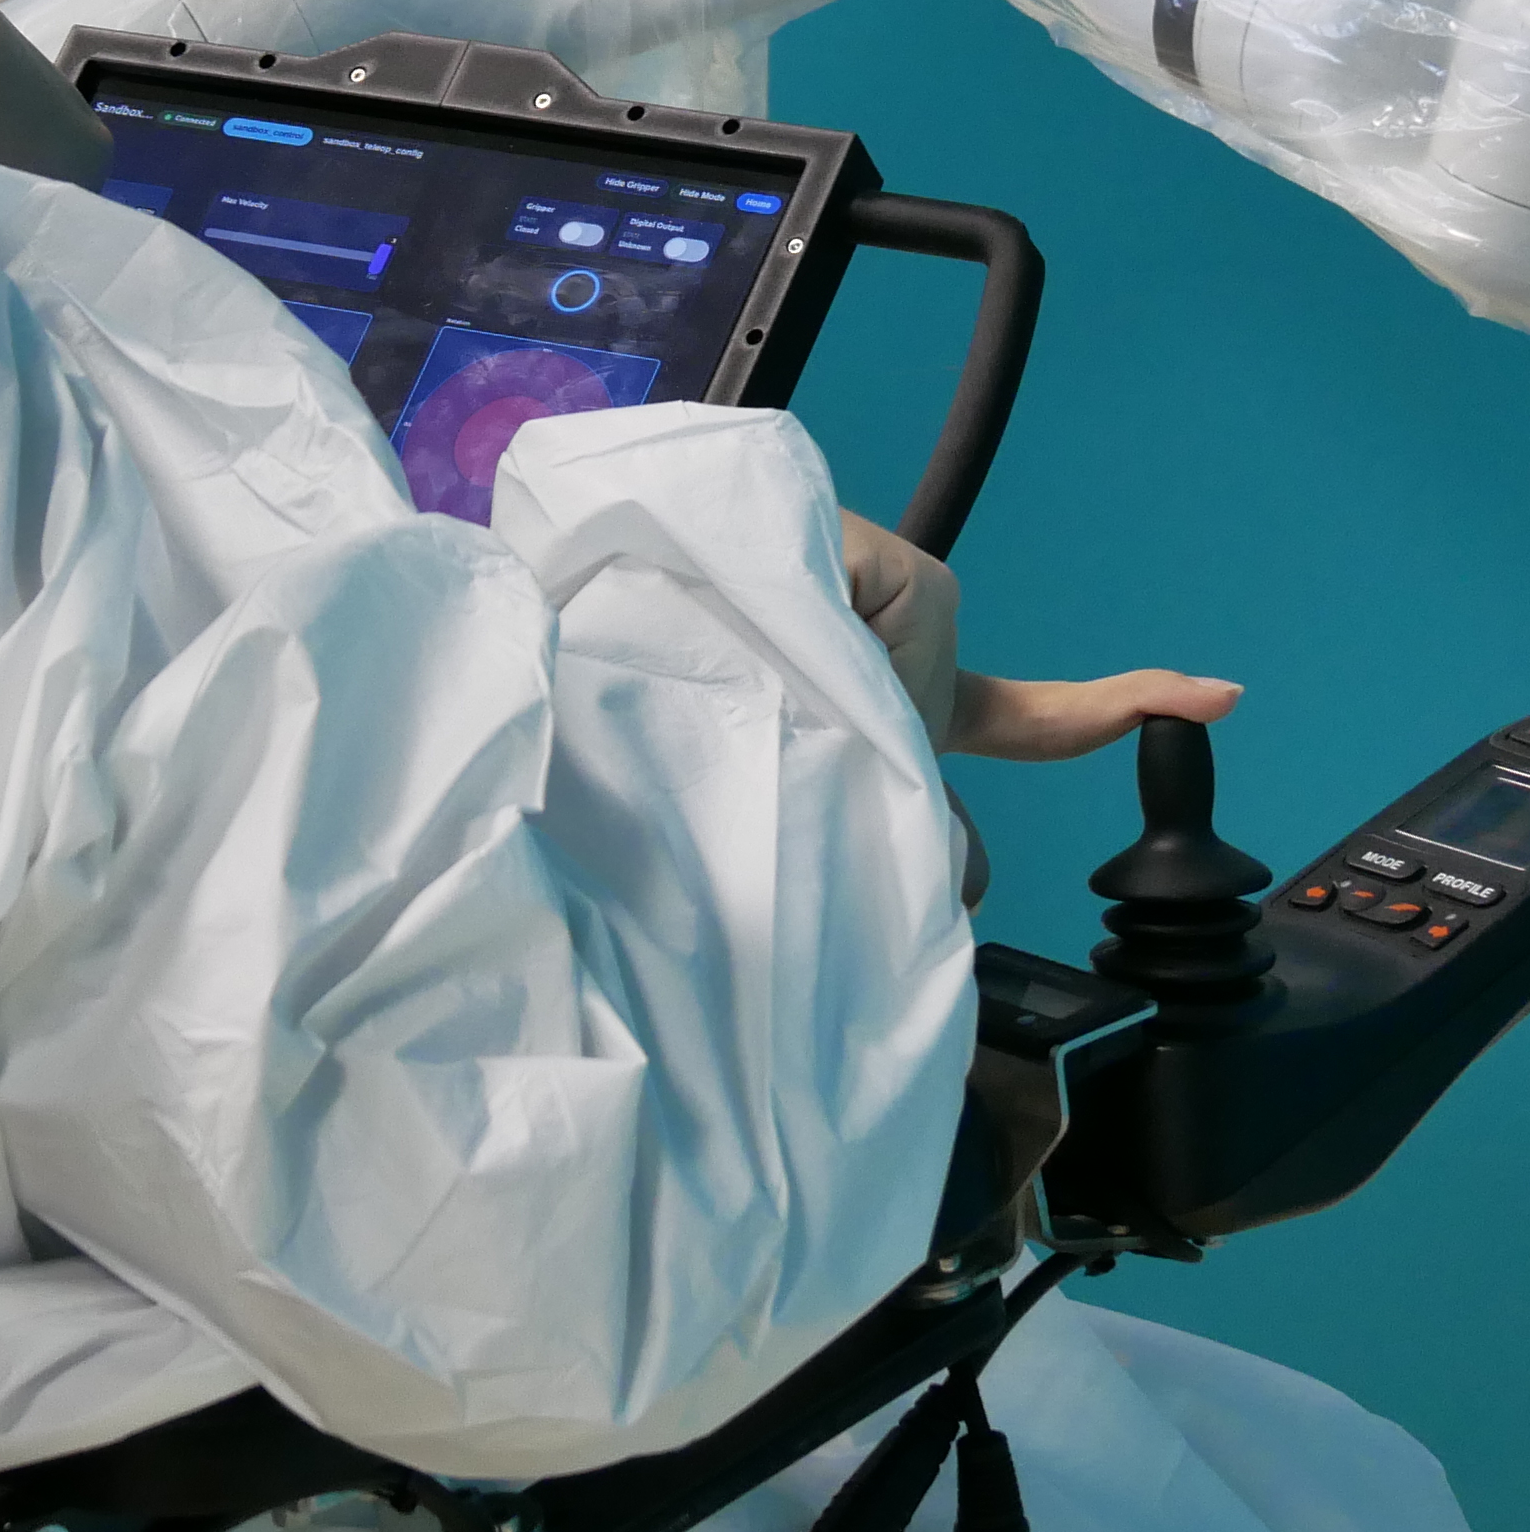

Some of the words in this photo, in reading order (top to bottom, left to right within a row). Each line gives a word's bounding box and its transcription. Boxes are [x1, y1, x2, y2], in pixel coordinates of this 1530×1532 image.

[174, 114, 218, 127] Connected
[233, 123, 305, 141] sandbox_control
[322, 137, 424, 159] sandbox_teleop_config
[605, 177, 625, 188] Hide
[627, 180, 660, 193] Gripper
[679, 187, 699, 198] Hide
[700, 191, 726, 202] Mode
[221, 195, 237, 205] Max
[239, 198, 269, 210] Velocity
[526, 202, 556, 213] Gripper
[746, 198, 772, 209] Home
[514, 224, 540, 235] Closed
[630, 218, 655, 229] Digital
[656, 222, 684, 233] Output
[618, 240, 652, 252] Unknown
[1361, 851, 1405, 871] MODE
[1432, 872, 1495, 898] PROFILE
